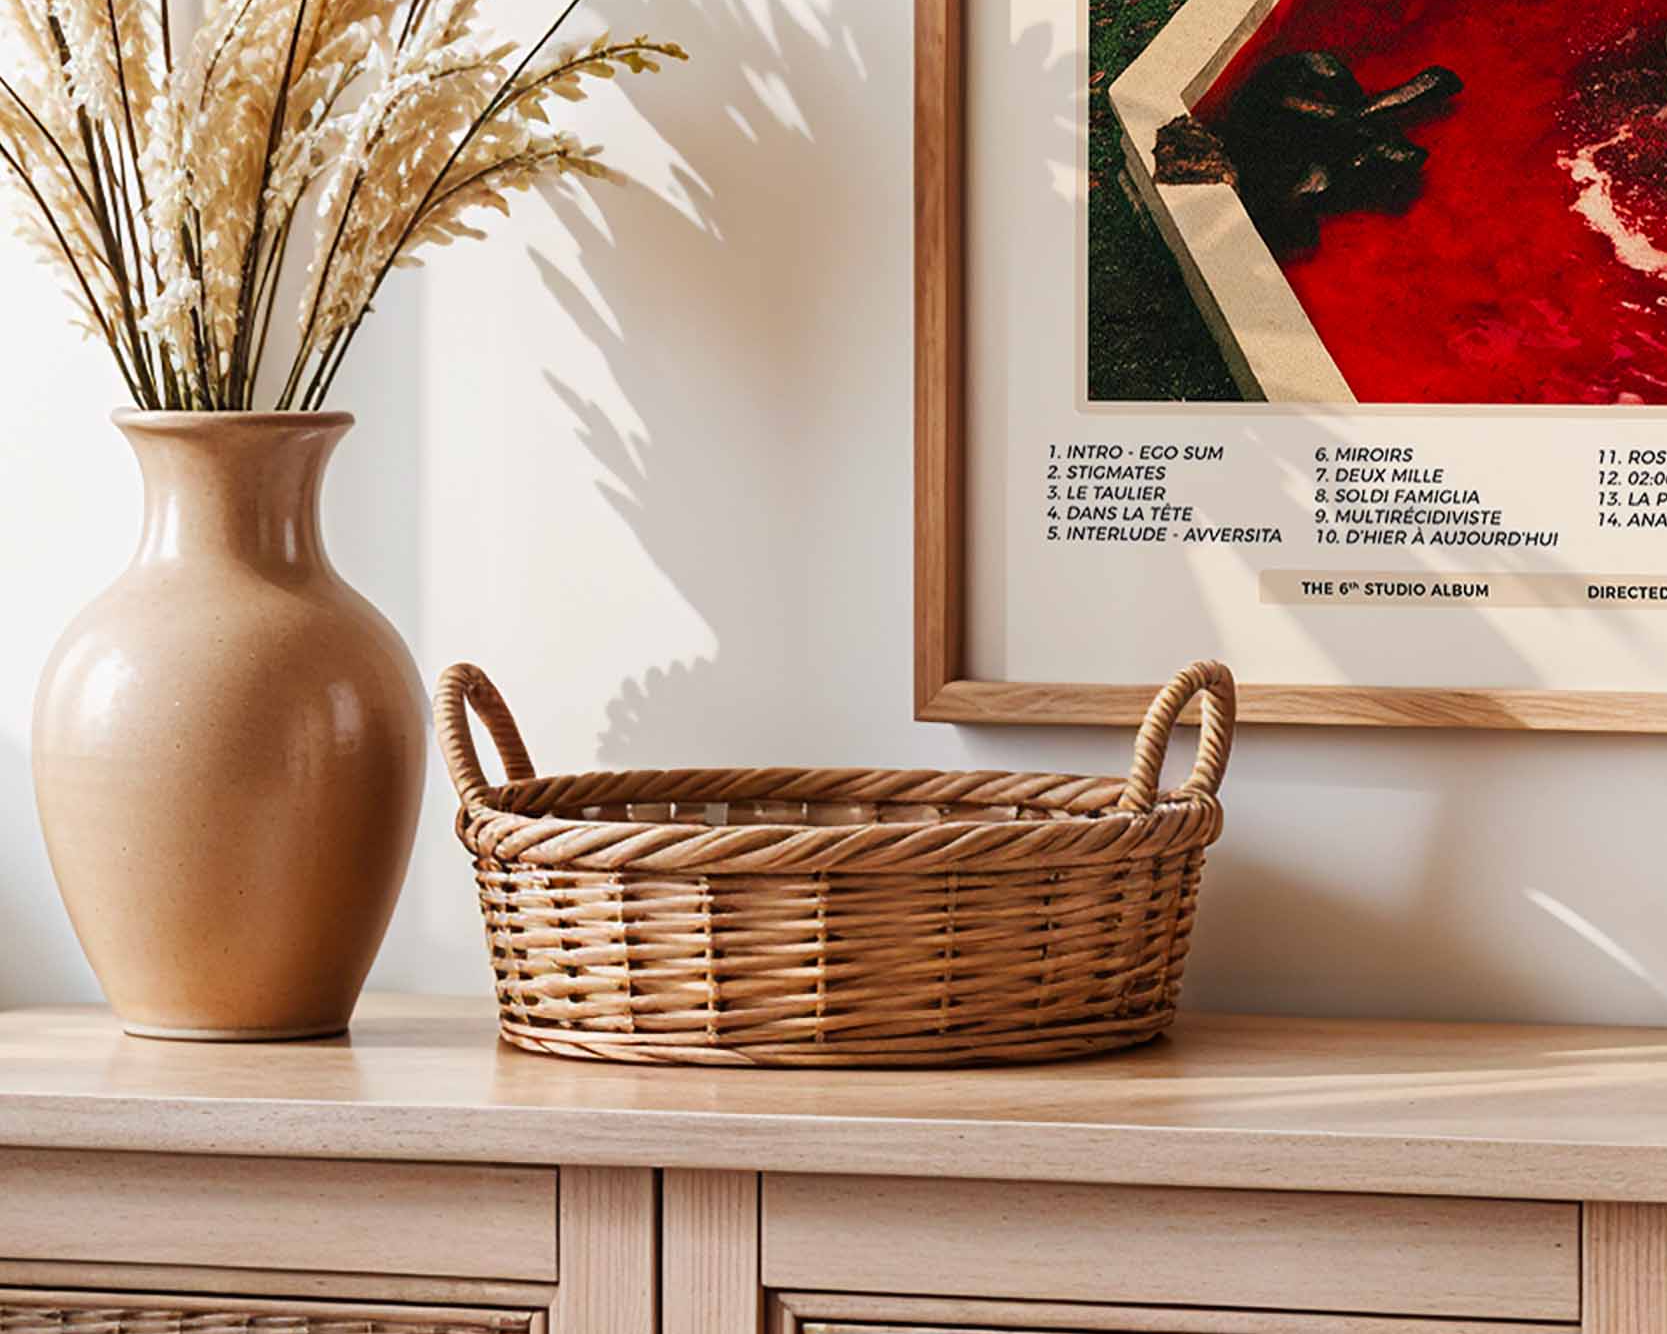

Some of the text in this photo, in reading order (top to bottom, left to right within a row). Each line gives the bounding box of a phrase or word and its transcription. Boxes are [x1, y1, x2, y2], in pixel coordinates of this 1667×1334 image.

[1049, 444, 1062, 459] 1.
[1066, 444, 1124, 460] INTRO
[1139, 444, 1179, 461] EGO
[1182, 445, 1225, 461] SUM
[1314, 446, 1414, 463] 6. MIROIRS
[1598, 449, 1622, 465] 11.
[1046, 464, 1167, 481] 2. STIGMATES
[1315, 467, 1445, 484] 7. DEUX MILLE
[1598, 470, 1622, 487] 12.
[1046, 484, 1166, 502] 3. LE TAULIER
[1314, 487, 1481, 504] 8. SOLDI FAMIGLIA
[1598, 491, 1622, 507] 13.
[1627, 491, 1651, 507] LA
[1046, 503, 1194, 523] 4. DANS LA TÊTE
[1314, 506, 1503, 526] 9. MULTIRÉCIDIVISTE
[1598, 511, 1622, 528] 14.
[1046, 525, 1062, 541] 5.
[1065, 525, 1168, 543] INTERLUDE
[1182, 527, 1283, 544] AVVERSITA
[1316, 528, 1340, 545] 10.
[1410, 526, 1425, 545] À
[1301, 580, 1489, 598] THE 6th STUDIO ALBUM
